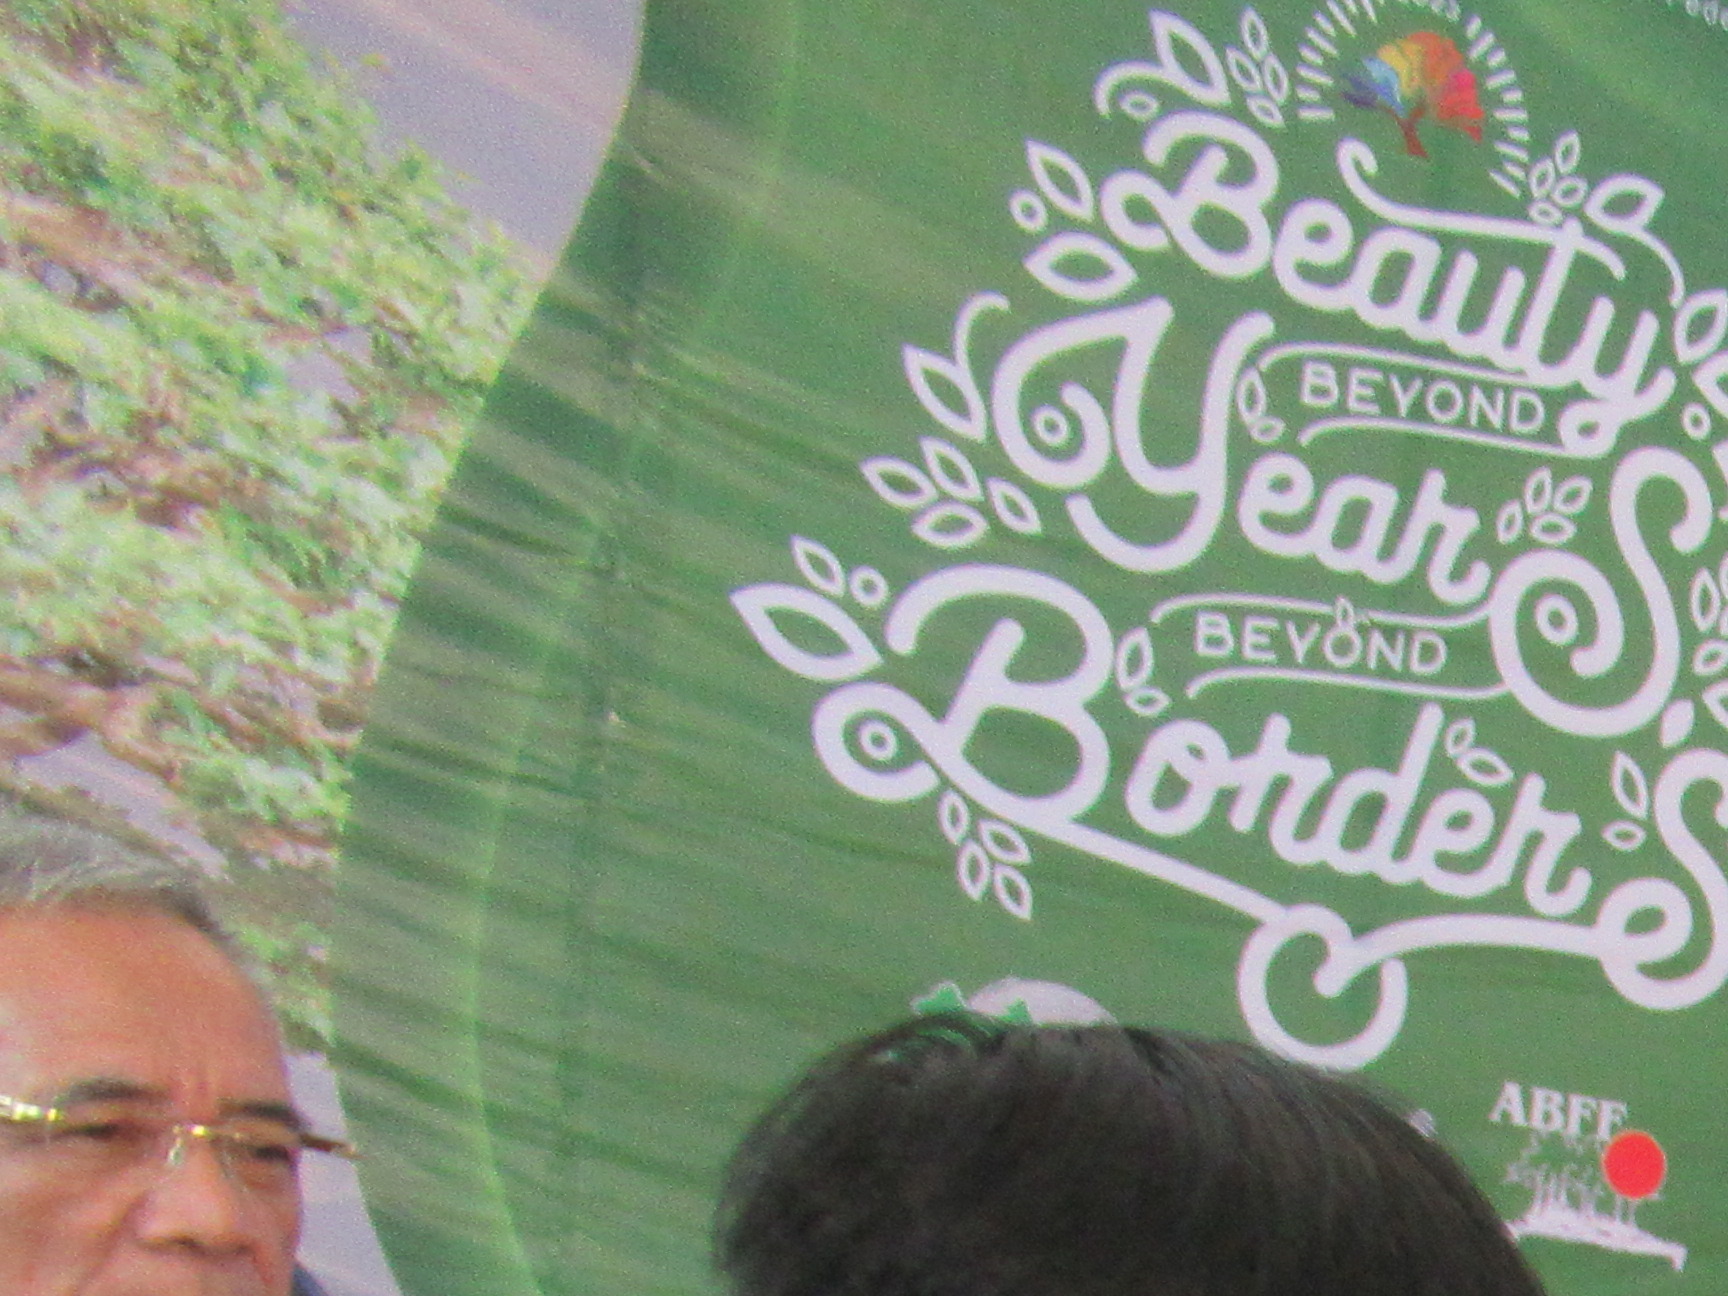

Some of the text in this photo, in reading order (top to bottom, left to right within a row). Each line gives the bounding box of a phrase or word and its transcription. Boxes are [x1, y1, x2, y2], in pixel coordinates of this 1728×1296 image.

[1098, 110, 1676, 457] Beauty
[1301, 363, 1546, 435] BEYOND
[1195, 612, 1448, 677] BEYOND
[1488, 1080, 1628, 1141] ABFF
